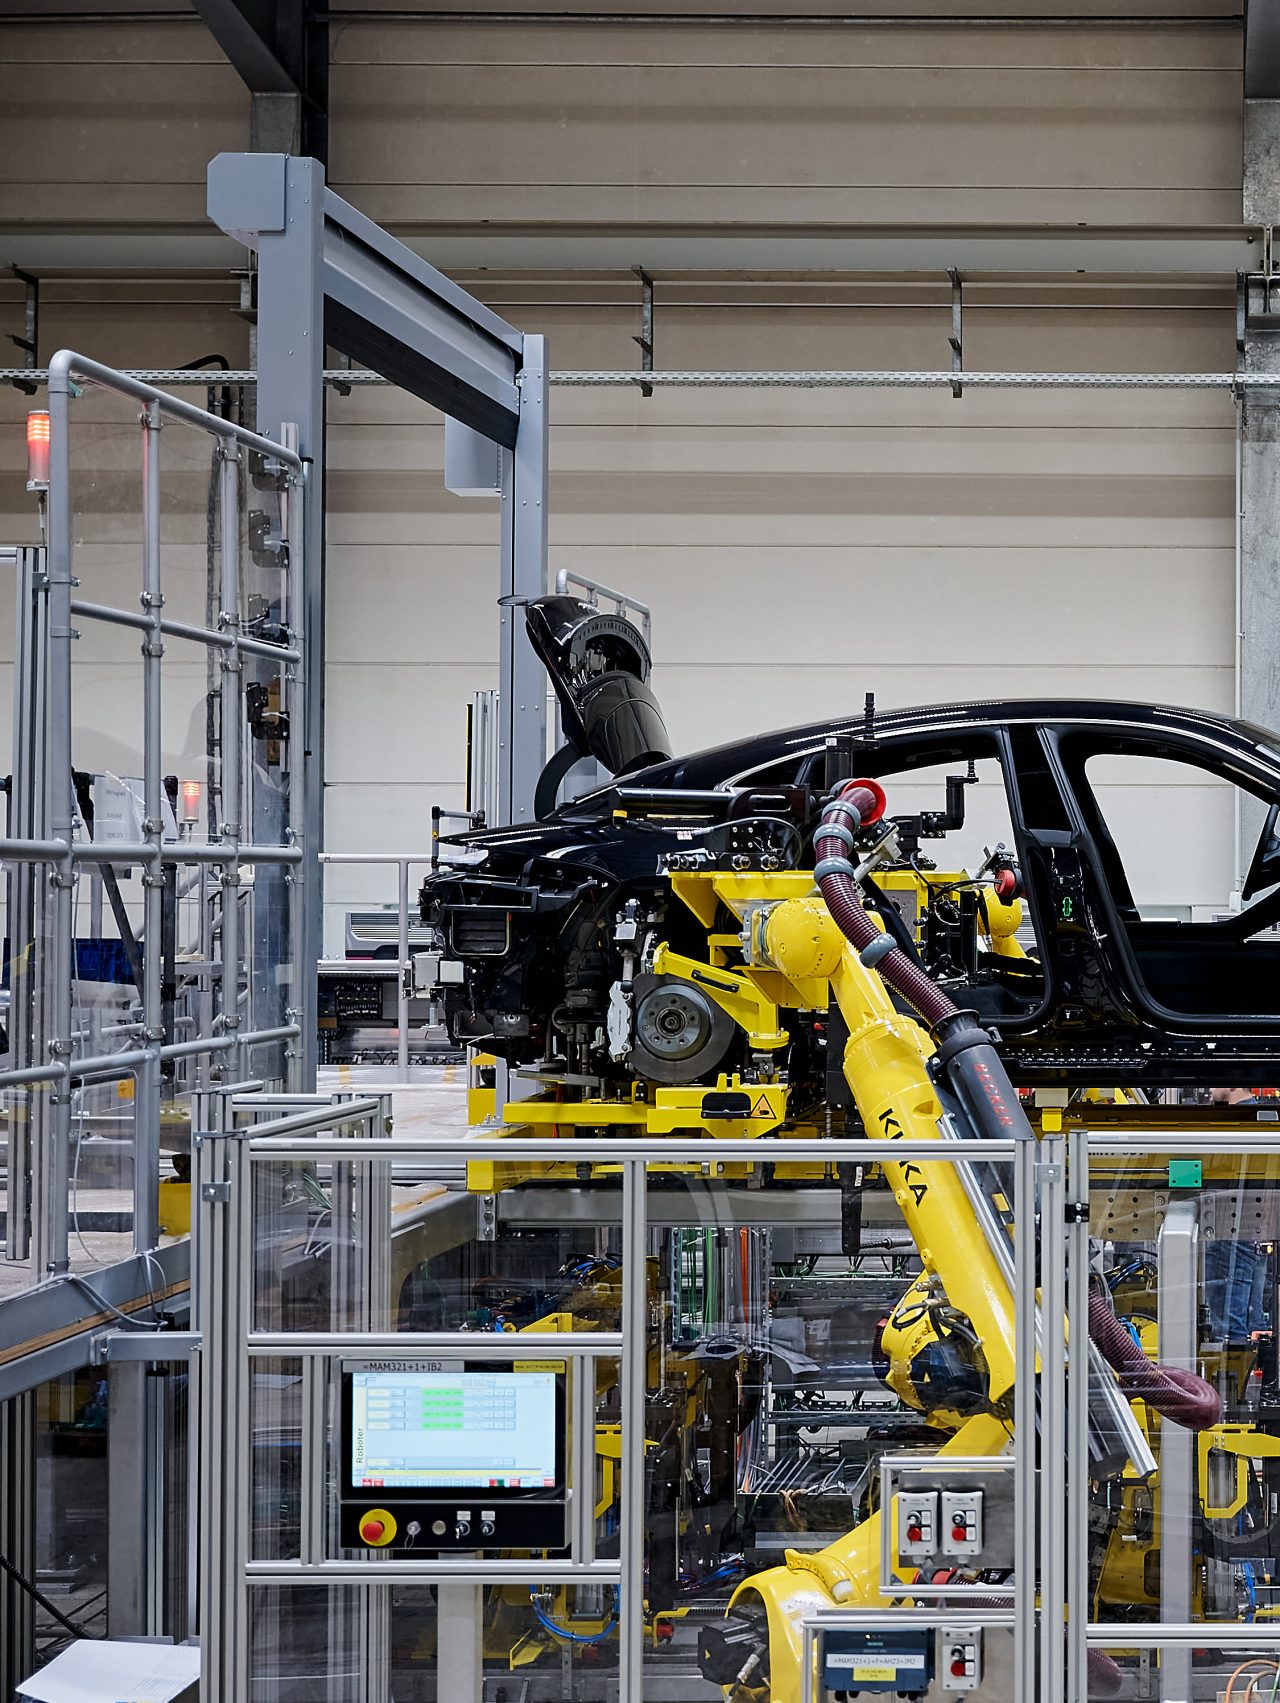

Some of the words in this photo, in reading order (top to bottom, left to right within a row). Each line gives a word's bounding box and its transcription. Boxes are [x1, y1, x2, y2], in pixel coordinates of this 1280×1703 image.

[973, 1063, 1016, 1127] BECKER
[878, 1107, 928, 1208] KKA
[363, 1362, 443, 1371] =MAM321+1+IB2
[355, 1428, 364, 1464] Roboter
